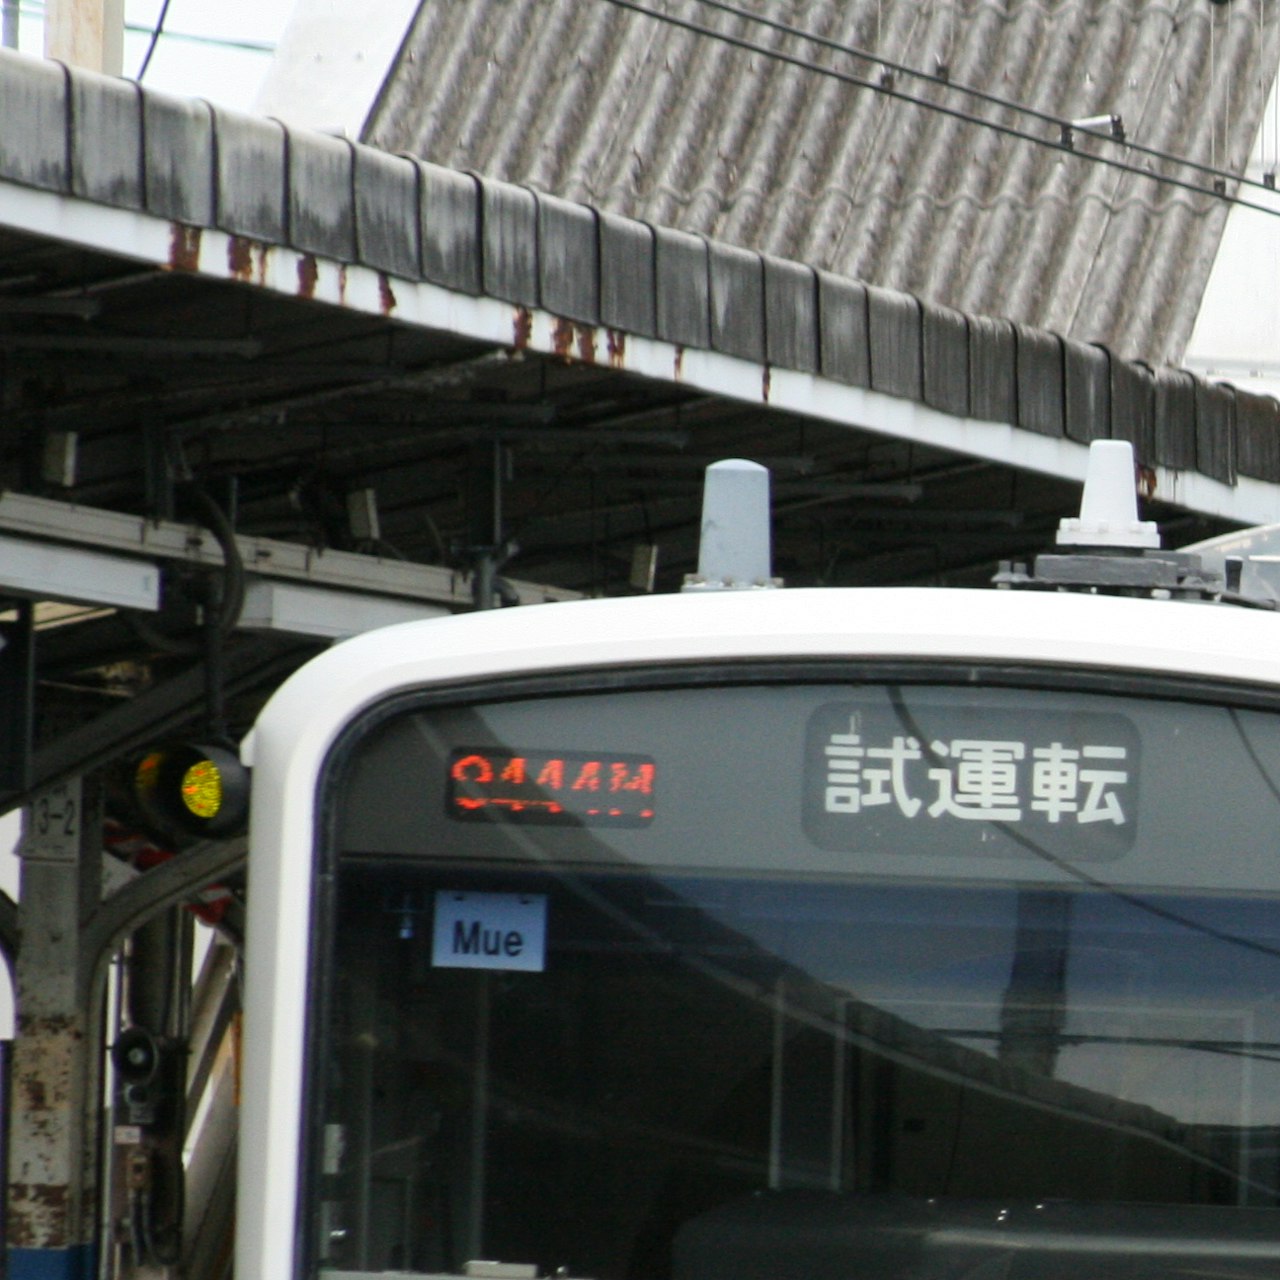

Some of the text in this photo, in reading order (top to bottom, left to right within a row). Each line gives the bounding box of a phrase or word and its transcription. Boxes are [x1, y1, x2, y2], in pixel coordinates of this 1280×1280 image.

[824, 734, 1129, 825] 試運転
[452, 920, 524, 957] Mue
